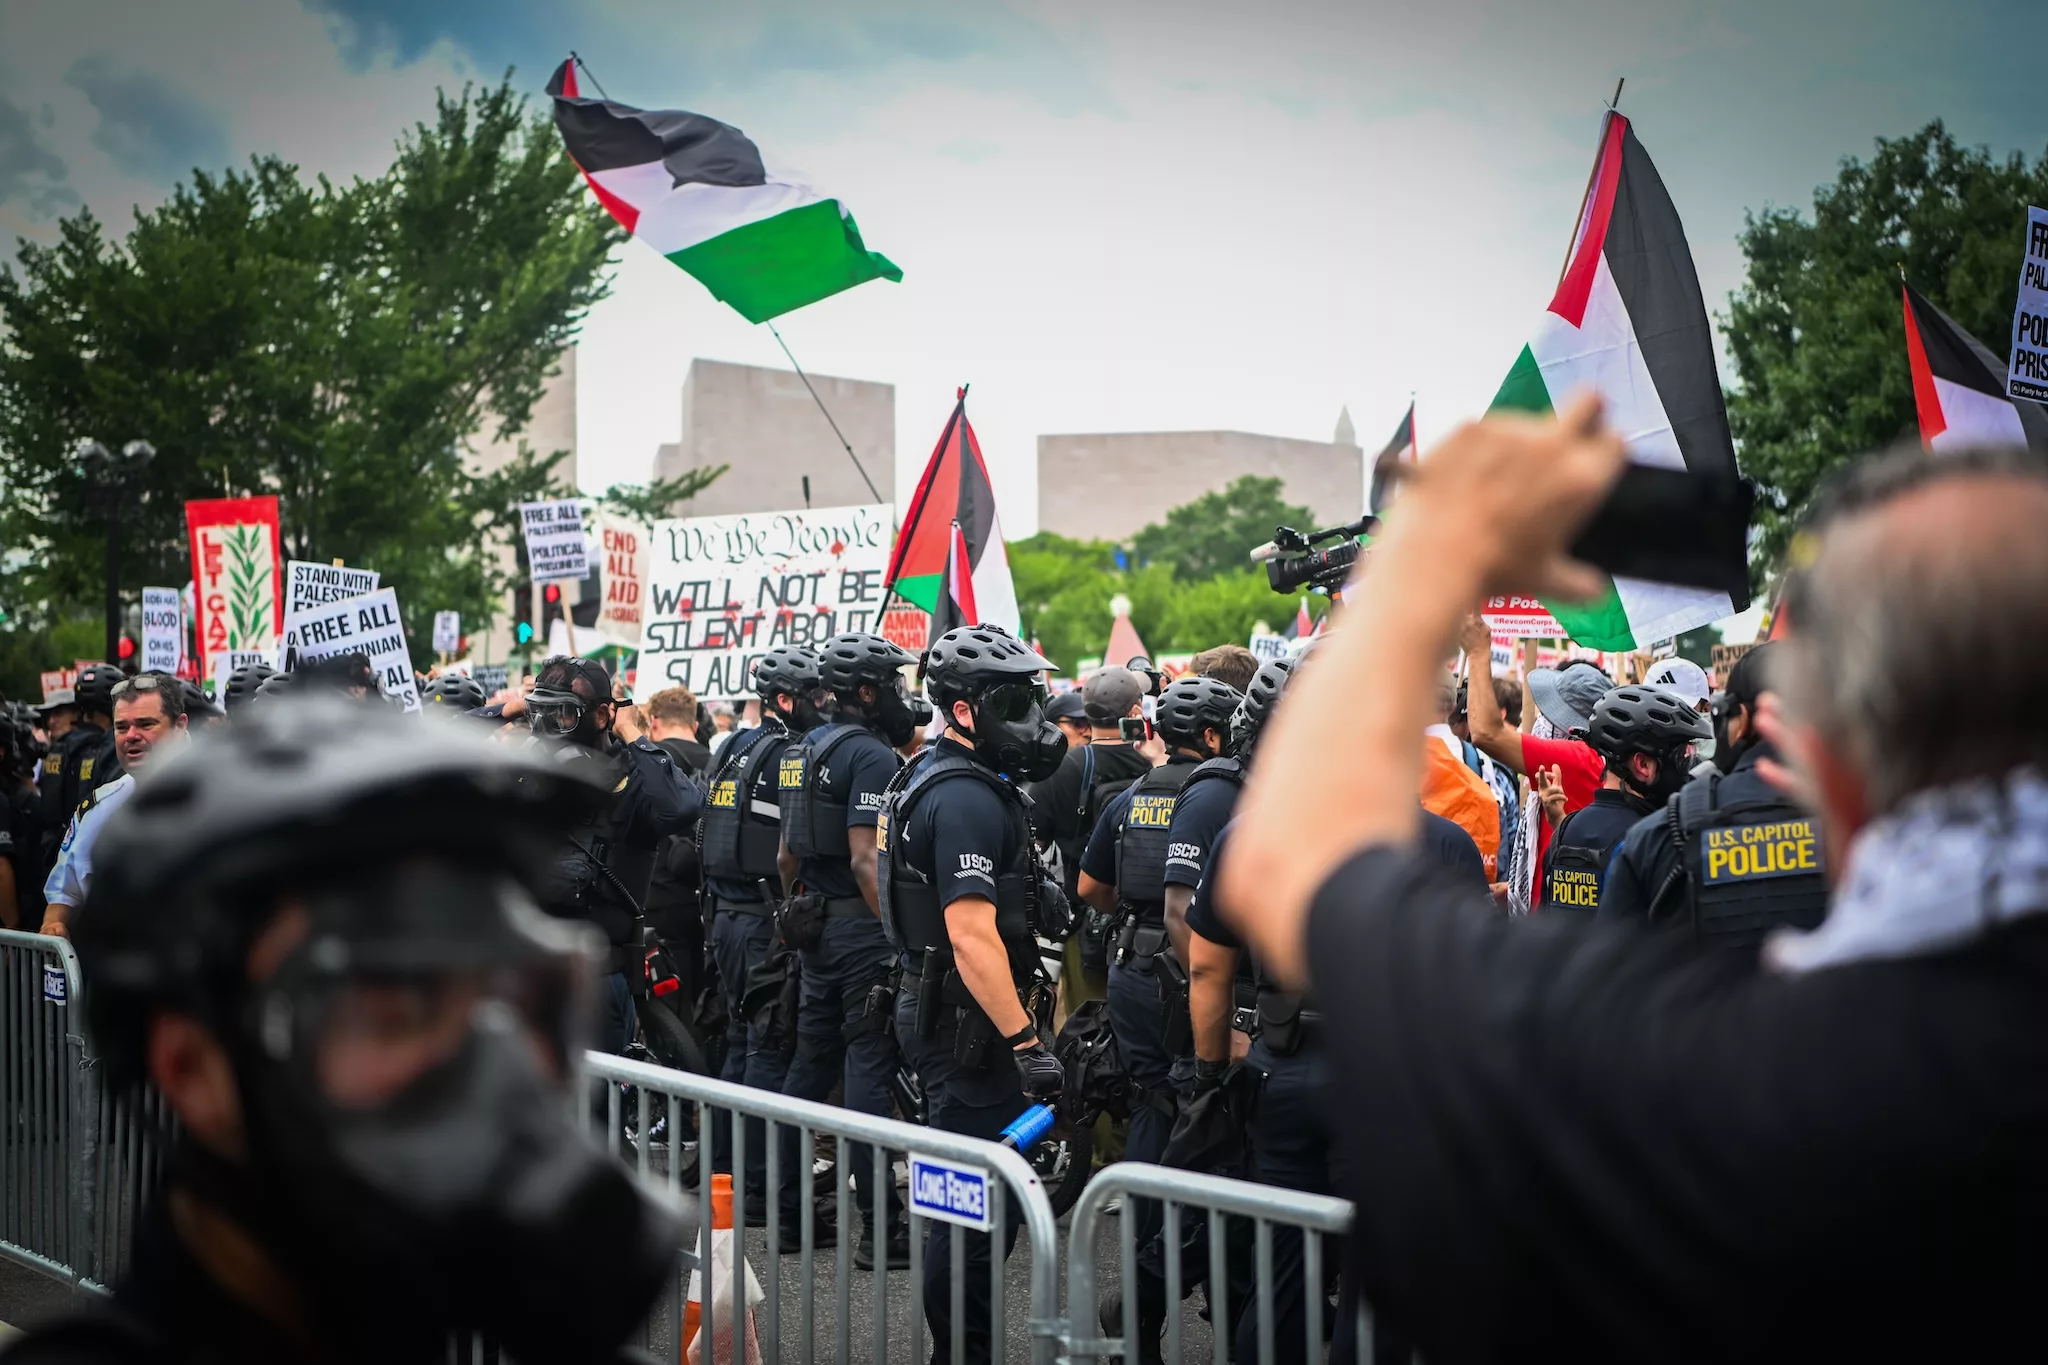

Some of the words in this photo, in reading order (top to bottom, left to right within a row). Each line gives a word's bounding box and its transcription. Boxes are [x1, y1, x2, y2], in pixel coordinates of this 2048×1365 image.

[525, 508, 553, 523] FREE
[558, 505, 578, 520] ALL
[604, 529, 637, 554] END
[666, 526, 715, 564] We
[770, 508, 881, 560] People
[201, 532, 223, 588] LET
[532, 543, 585, 559] POLITICAL
[295, 566, 340, 586] STAND
[343, 572, 374, 591] WITH
[607, 554, 638, 579] ALL
[607, 580, 639, 605] AID
[652, 578, 743, 616] WILL
[757, 573, 826, 609] NOT
[838, 570, 881, 604] BE
[144, 611, 178, 628] BLOOD
[300, 613, 353, 647] FREE
[358, 604, 397, 633] ALL
[644, 616, 766, 654] SILENT
[769, 610, 875, 647] ABOUT
[779, 769, 804, 787] POLICE
[1133, 797, 1147, 807] U.S.
[1708, 830, 1740, 848] U.S.
[1742, 821, 1815, 844] CAPITOL
[958, 853, 994, 873] USCP
[1168, 842, 1201, 860] USCP
[1709, 838, 1817, 879] POLICE
[1553, 869, 1565, 882] U.S.
[1565, 870, 1598, 886] CAPITOL
[1552, 882, 1599, 908] POLICE
